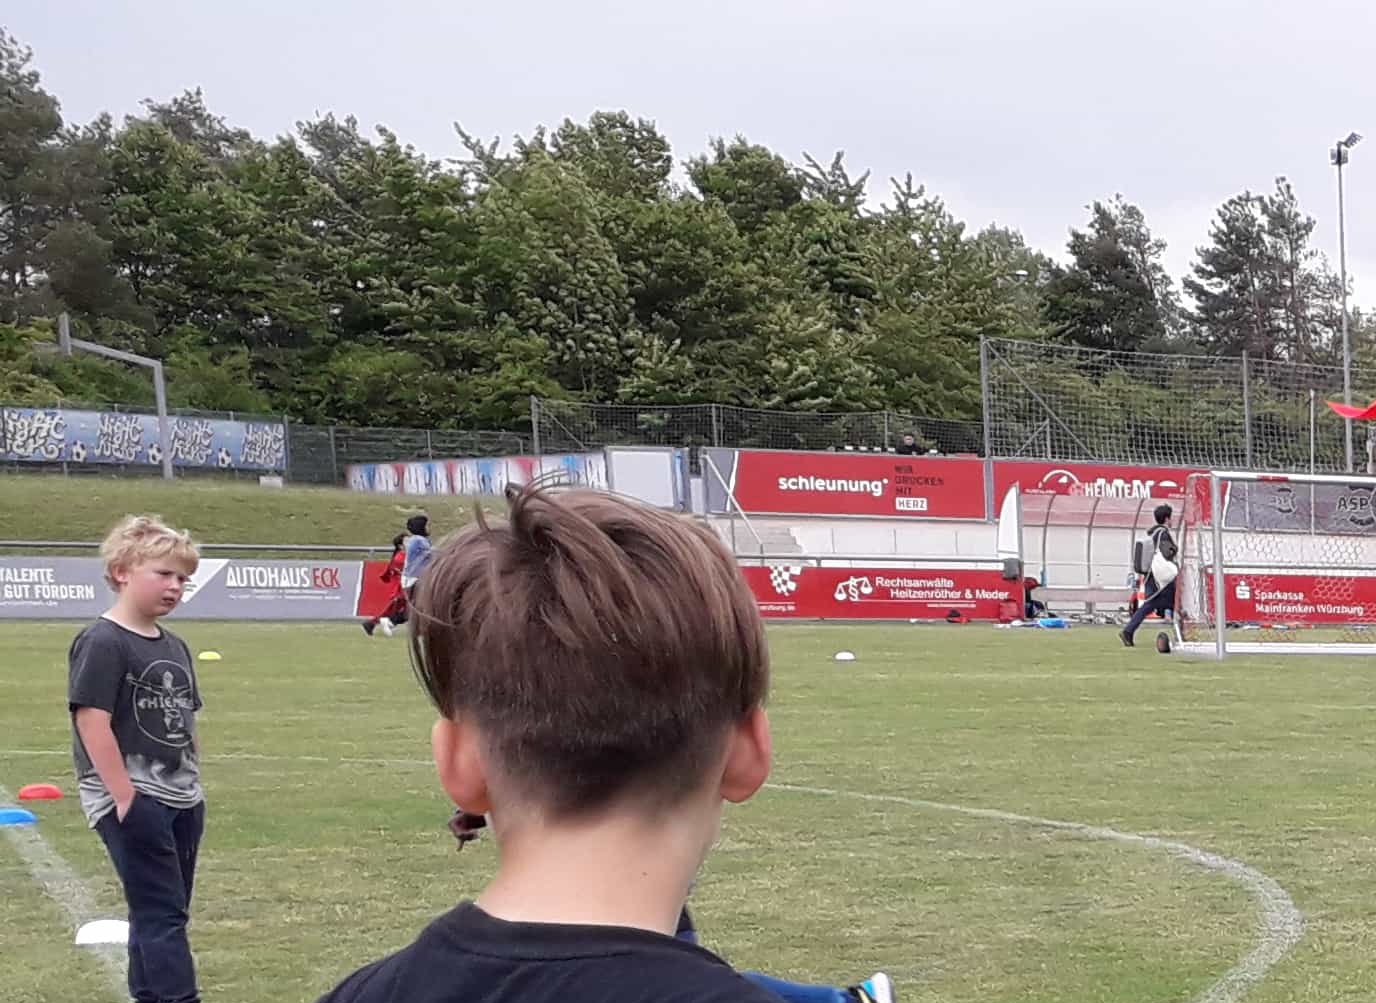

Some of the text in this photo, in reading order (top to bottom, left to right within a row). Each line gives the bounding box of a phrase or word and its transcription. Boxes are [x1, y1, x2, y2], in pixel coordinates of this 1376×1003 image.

[778, 476, 882, 497] schleunung
[898, 499, 926, 509] HERZ
[226, 567, 341, 588] AUTOHAUS ECK
[4, 584, 31, 599] GUT
[964, 590, 973, 600] &
[1254, 590, 1304, 602] Sparkasse
[1255, 603, 1315, 614] Mainfranken
